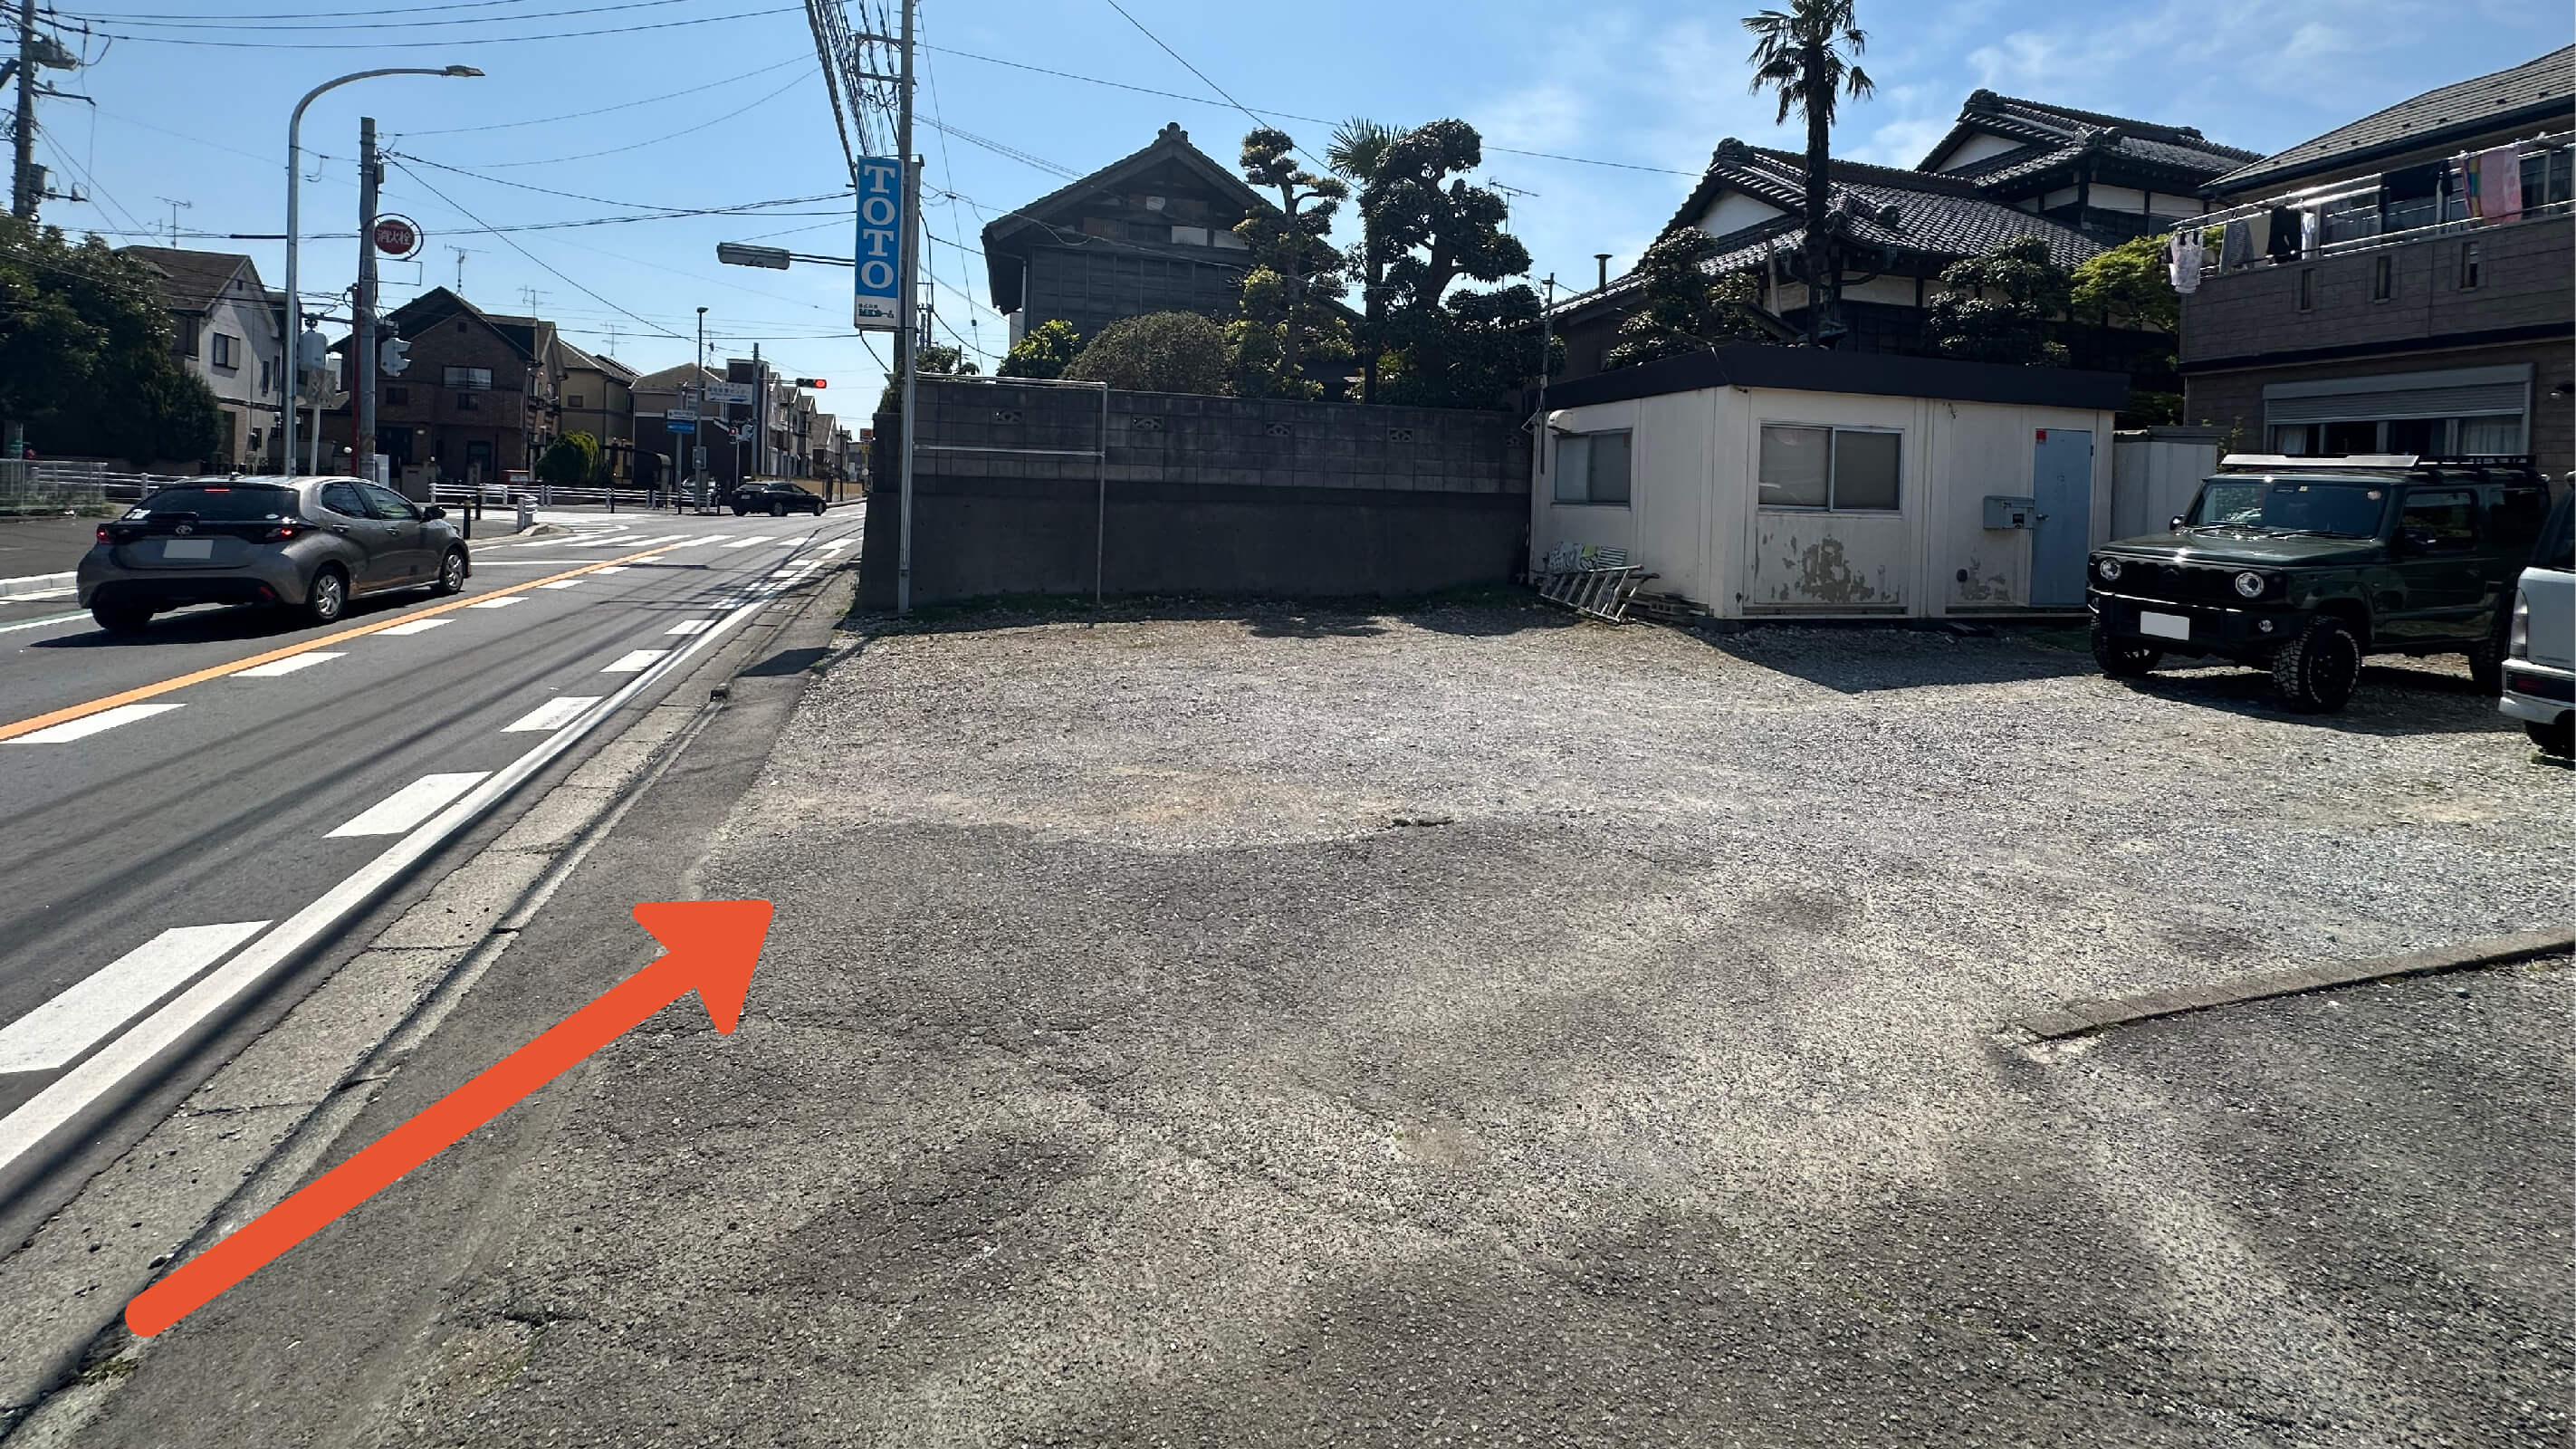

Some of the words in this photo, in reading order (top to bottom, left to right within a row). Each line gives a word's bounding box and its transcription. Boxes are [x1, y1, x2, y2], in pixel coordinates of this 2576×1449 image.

[377, 228, 410, 245] 消火栓
[861, 165, 895, 289] TOTO
